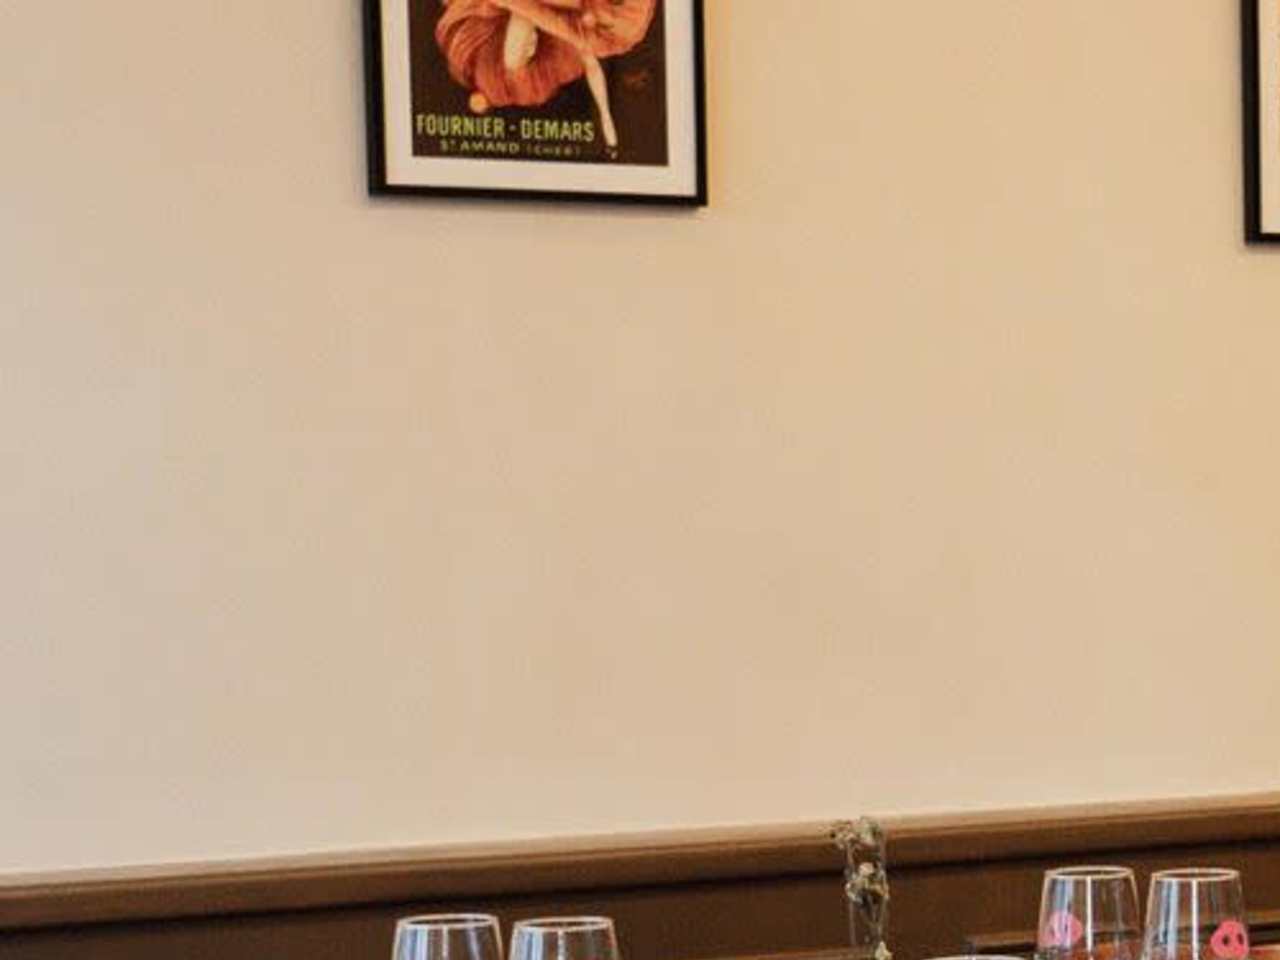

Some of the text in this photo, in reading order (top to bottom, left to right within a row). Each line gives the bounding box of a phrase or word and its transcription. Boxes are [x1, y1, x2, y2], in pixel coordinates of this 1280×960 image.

[416, 114, 504, 137] FOURNIER
[520, 118, 595, 141] DEMARS
[460, 141, 520, 154] AMAND
